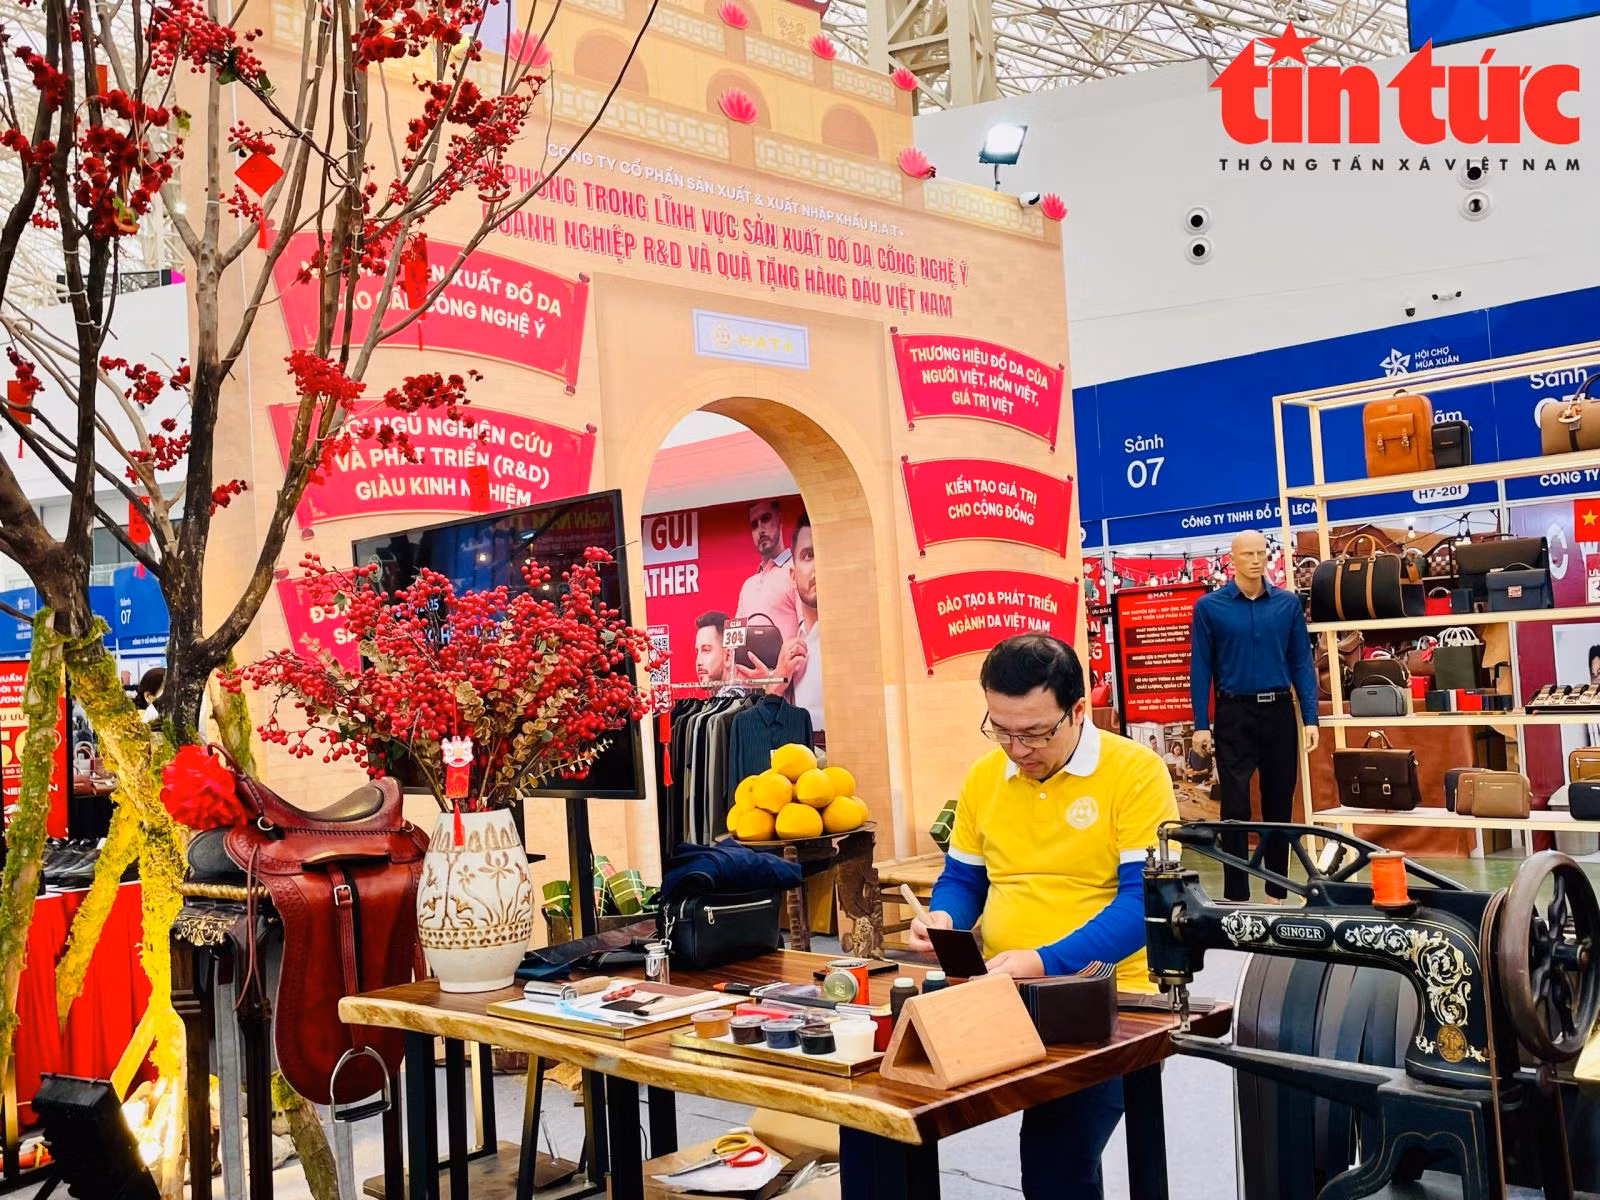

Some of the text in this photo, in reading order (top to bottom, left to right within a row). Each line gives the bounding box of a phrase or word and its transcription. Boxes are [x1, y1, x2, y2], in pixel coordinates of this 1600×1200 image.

[548, 143, 593, 166] CÔNG
[598, 155, 617, 171] TY
[620, 158, 643, 177] CỔ
[646, 166, 684, 188] PHẦN
[687, 176, 714, 195] SẢN
[717, 184, 751, 204] XUẤT
[755, 194, 763, 206] &
[767, 194, 800, 214] XUẤT
[802, 205, 834, 223] NHẬP
[836, 212, 868, 230] KHẨU
[503, 164, 577, 207] PHONG
[583, 181, 648, 222] TRONG
[655, 192, 697, 232] LĨNH
[702, 208, 739, 243] VỰC
[743, 212, 778, 249] SẢN
[783, 225, 823, 258] XUẤT
[827, 234, 849, 263] ĐỒ
[853, 242, 874, 268] DA
[878, 243, 917, 277] CÔNG
[920, 255, 957, 290] NGHỆ
[959, 260, 969, 287] Ý
[564, 219, 637, 264] NGHIỆP
[643, 236, 682, 269] R&D
[688, 242, 712, 274] VÀ
[717, 250, 752, 282] QUÀ
[757, 255, 800, 291] TẶNG
[804, 265, 847, 299] HÀNG
[851, 275, 882, 305] ĐẦU
[886, 282, 916, 316] VIỆT
[920, 291, 953, 319] NAM
[451, 267, 502, 295] XUẤT
[505, 281, 534, 305] ĐỒ
[536, 293, 562, 318] DA
[481, 304, 530, 338] NGHỆ
[534, 317, 546, 339] Ý
[910, 345, 1049, 390] THƯƠNG HIỆU ĐỒ DA CỦA
[1415, 346, 1449, 360] HỘI CHỢ
[1415, 355, 1459, 370] MÙA XUÂN
[921, 365, 1039, 408] NGƯỜI VIỆT, HỒN VIỆT,
[952, 388, 1014, 415] GIÁ TRỊ VIỆT
[427, 417, 506, 445] NGHIÊN
[510, 432, 552, 459] CỨU
[1124, 434, 1164, 453] Sảnh
[334, 445, 367, 473] VÀ
[430, 442, 489, 468] TRIỂN
[493, 454, 550, 489] (R&D)
[1127, 456, 1164, 488] 07
[1584, 468, 1600, 482] TY
[356, 473, 532, 510] GIÀU KINH NHIỆM
[945, 474, 1037, 510] KIẾN TẠO GIÁ TRỊ
[948, 498, 1035, 526] CHO CỘNG ĐỒNG
[1181, 515, 1211, 529] CÔNG
[1214, 513, 1225, 525] TY
[1227, 510, 1254, 523] TNHH
[1256, 503, 1272, 520] ĐỒ
[1275, 507, 1281, 518] D
[651, 511, 693, 551] GUI
[120, 609, 132, 625] 07
[937, 589, 1058, 616] ĐÀO TẠO & PHÁT TRIỂN
[725, 629, 744, 645] 30%
[948, 611, 1051, 637] NGÀNH DA VIỆT NAM
[1280, 926, 1322, 940] SINGER
